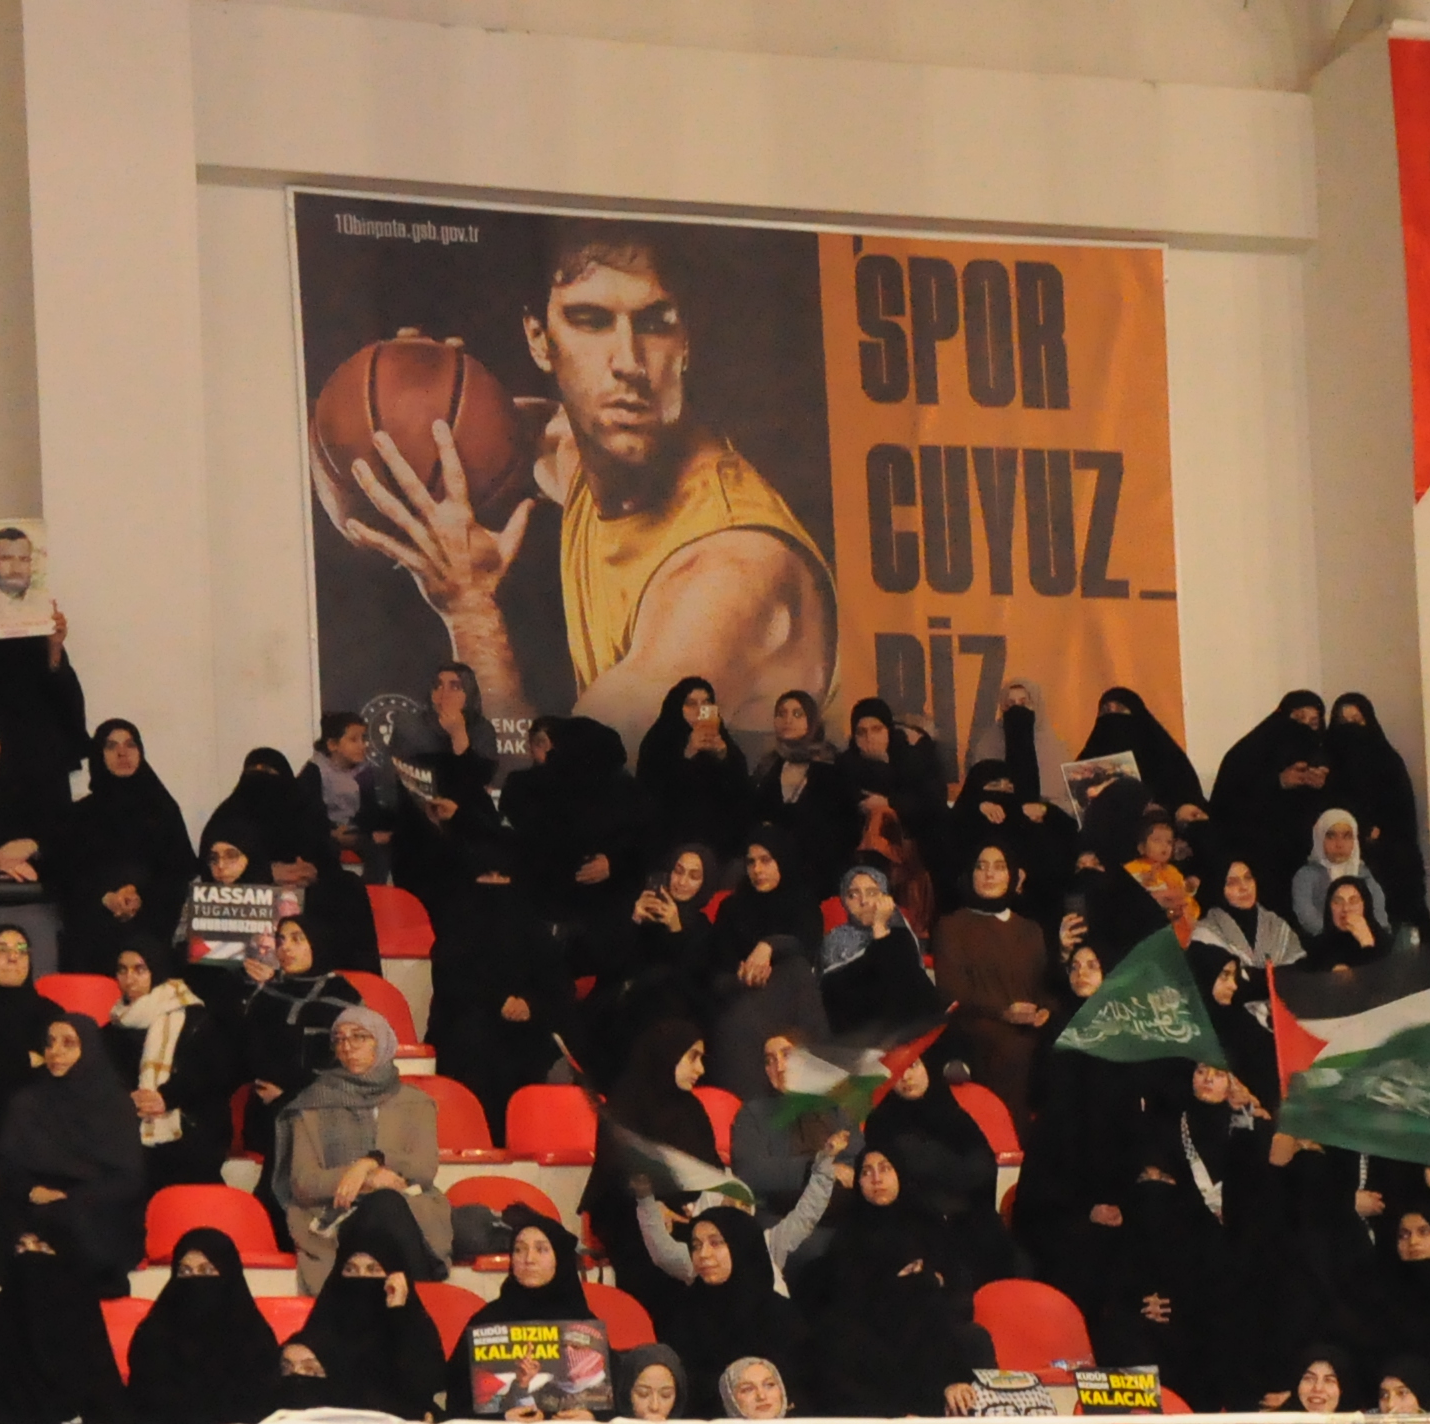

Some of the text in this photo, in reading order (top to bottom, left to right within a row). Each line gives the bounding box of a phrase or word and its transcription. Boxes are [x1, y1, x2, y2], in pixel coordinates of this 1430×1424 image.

[334, 213, 480, 245] 10binpota.gsb.gov.tr
[853, 253, 1070, 410] SPOR
[193, 885, 274, 905] KASSAM
[193, 904, 273, 918] TUGAYLARI
[1079, 1390, 1158, 1408] KALACAK
